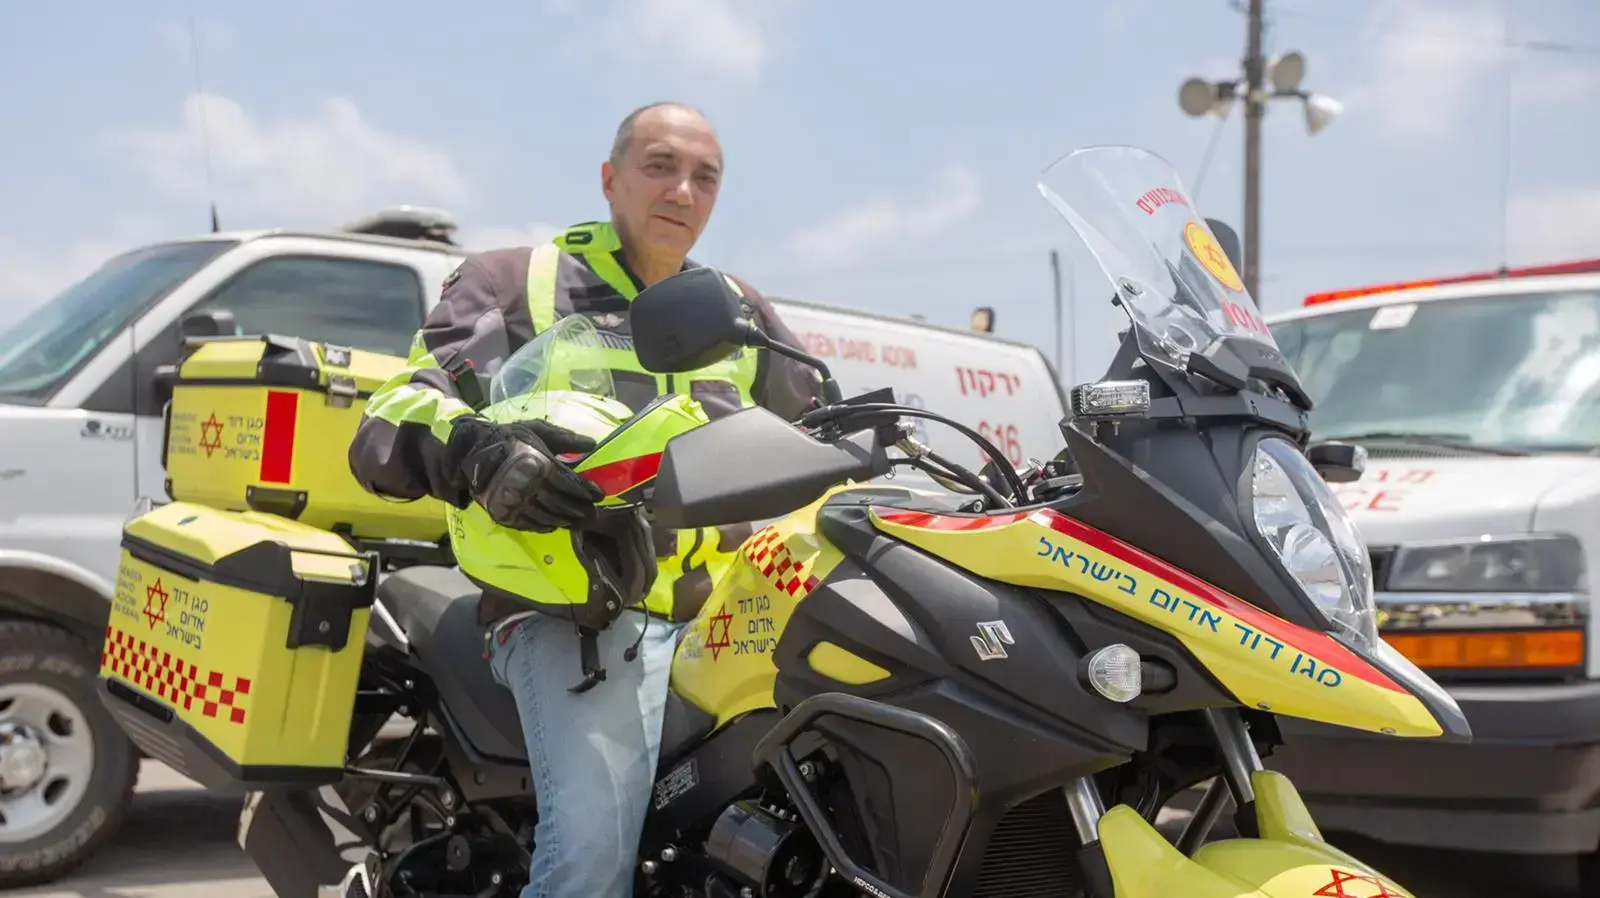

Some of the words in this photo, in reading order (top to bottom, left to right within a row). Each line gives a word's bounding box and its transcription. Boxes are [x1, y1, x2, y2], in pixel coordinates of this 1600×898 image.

[956, 366, 1021, 398] ירקון
[1037, 536, 1138, 597] בישראל
[173, 587, 189, 605] דוד
[191, 595, 209, 613] מגן
[757, 595, 771, 615] מגן
[737, 599, 753, 615] דוד
[1149, 588, 1223, 633] אדום
[180, 611, 205, 632] אדום
[747, 617, 775, 635] אדום
[166, 620, 202, 650] בישראל
[1234, 622, 1285, 661] דוד
[732, 638, 777, 656] בישראל
[1290, 653, 1342, 689] מגן
